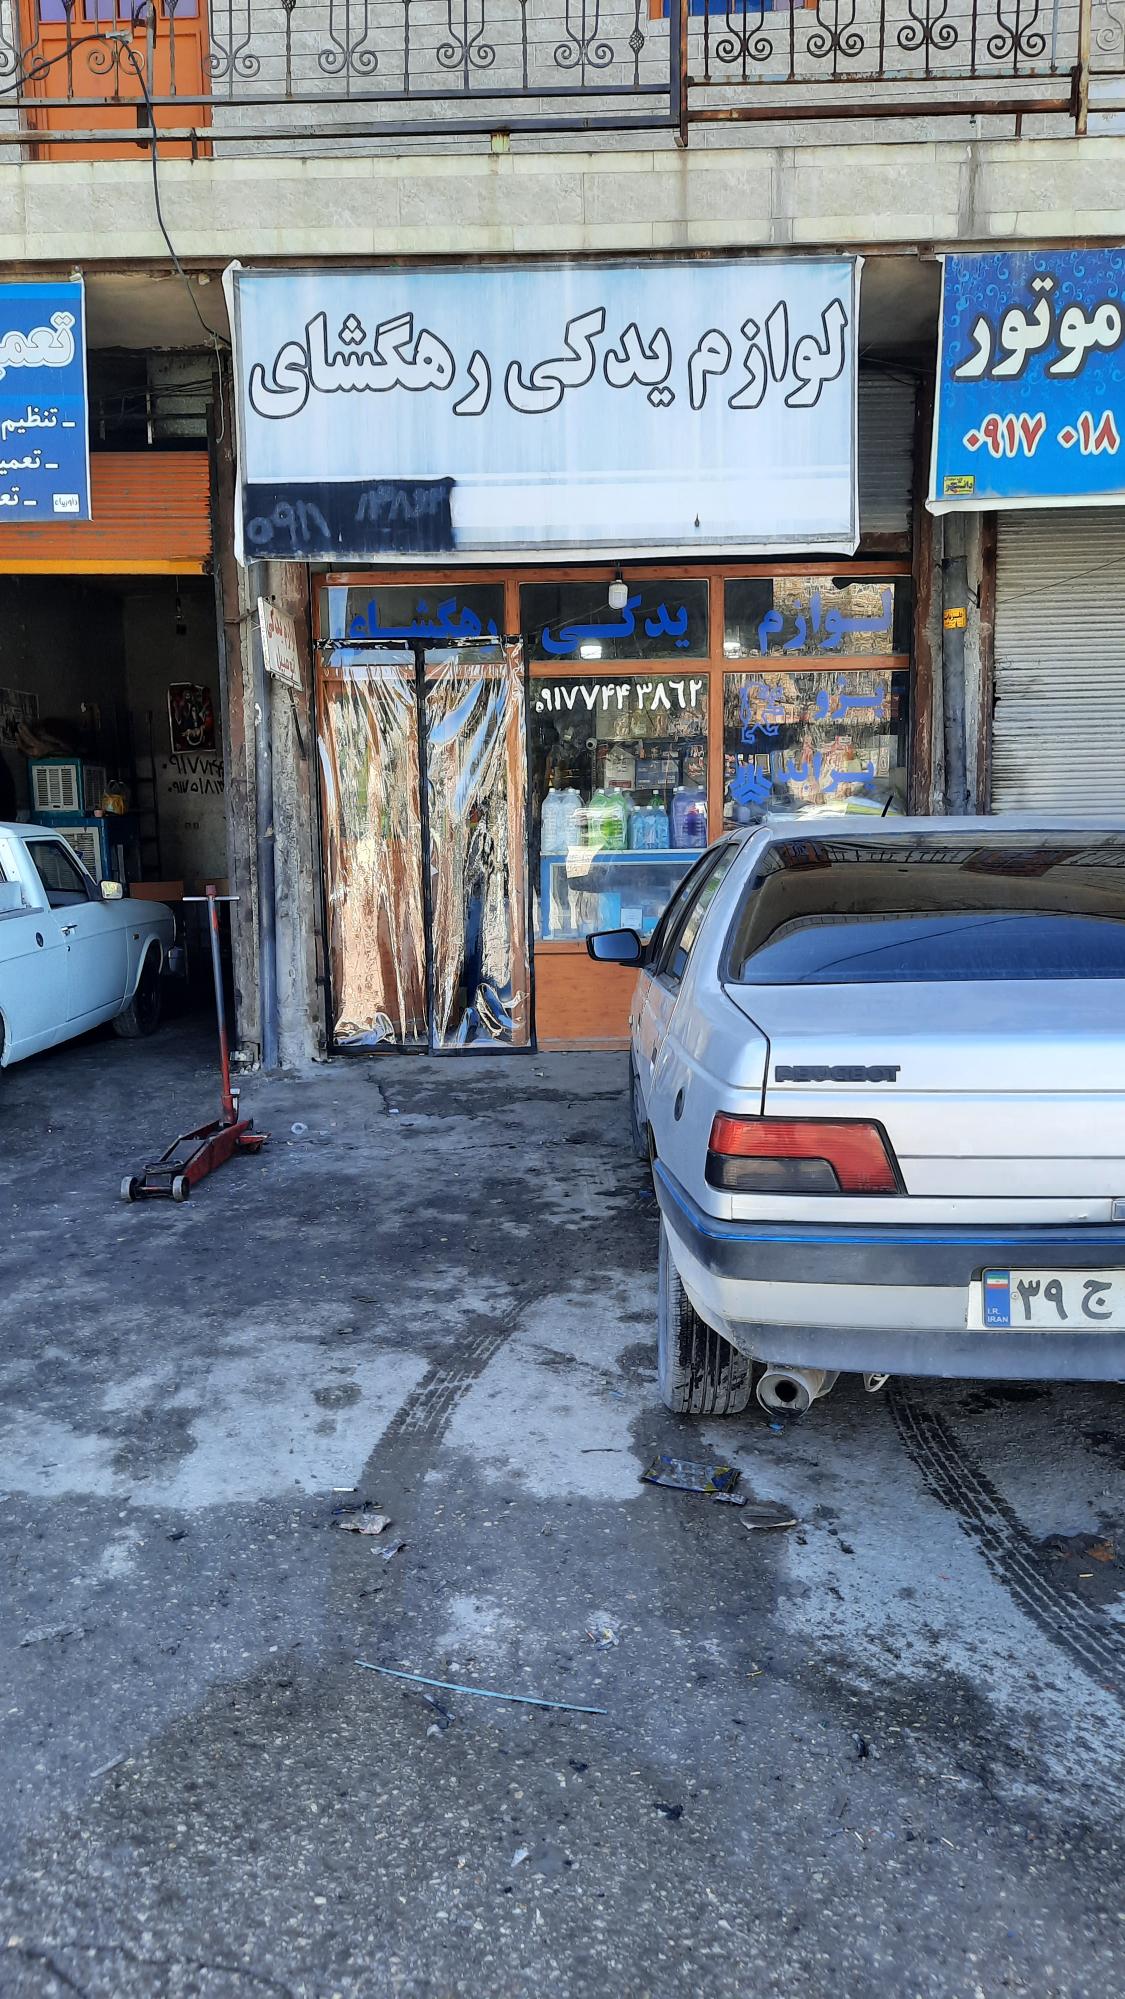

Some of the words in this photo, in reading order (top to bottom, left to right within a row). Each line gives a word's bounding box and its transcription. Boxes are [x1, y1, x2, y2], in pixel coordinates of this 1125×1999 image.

[688, 297, 849, 411] لوازم
[953, 275, 1123, 378] موتور
[248, 311, 492, 420] رهگشای
[504, 306, 675, 414] یدکی
[2, 405, 58, 440] تنظیم
[963, 412, 1047, 459] ۰۹۱۷
[1057, 409, 1121, 456] ۰۱۸
[541, 594, 689, 655] یدکی
[757, 587, 893, 656] لوازم
[775, 1065, 901, 1083] PEUGEOT
[1016, 1278, 1069, 1321] ۳۹
[1081, 1278, 1113, 1321] ج
